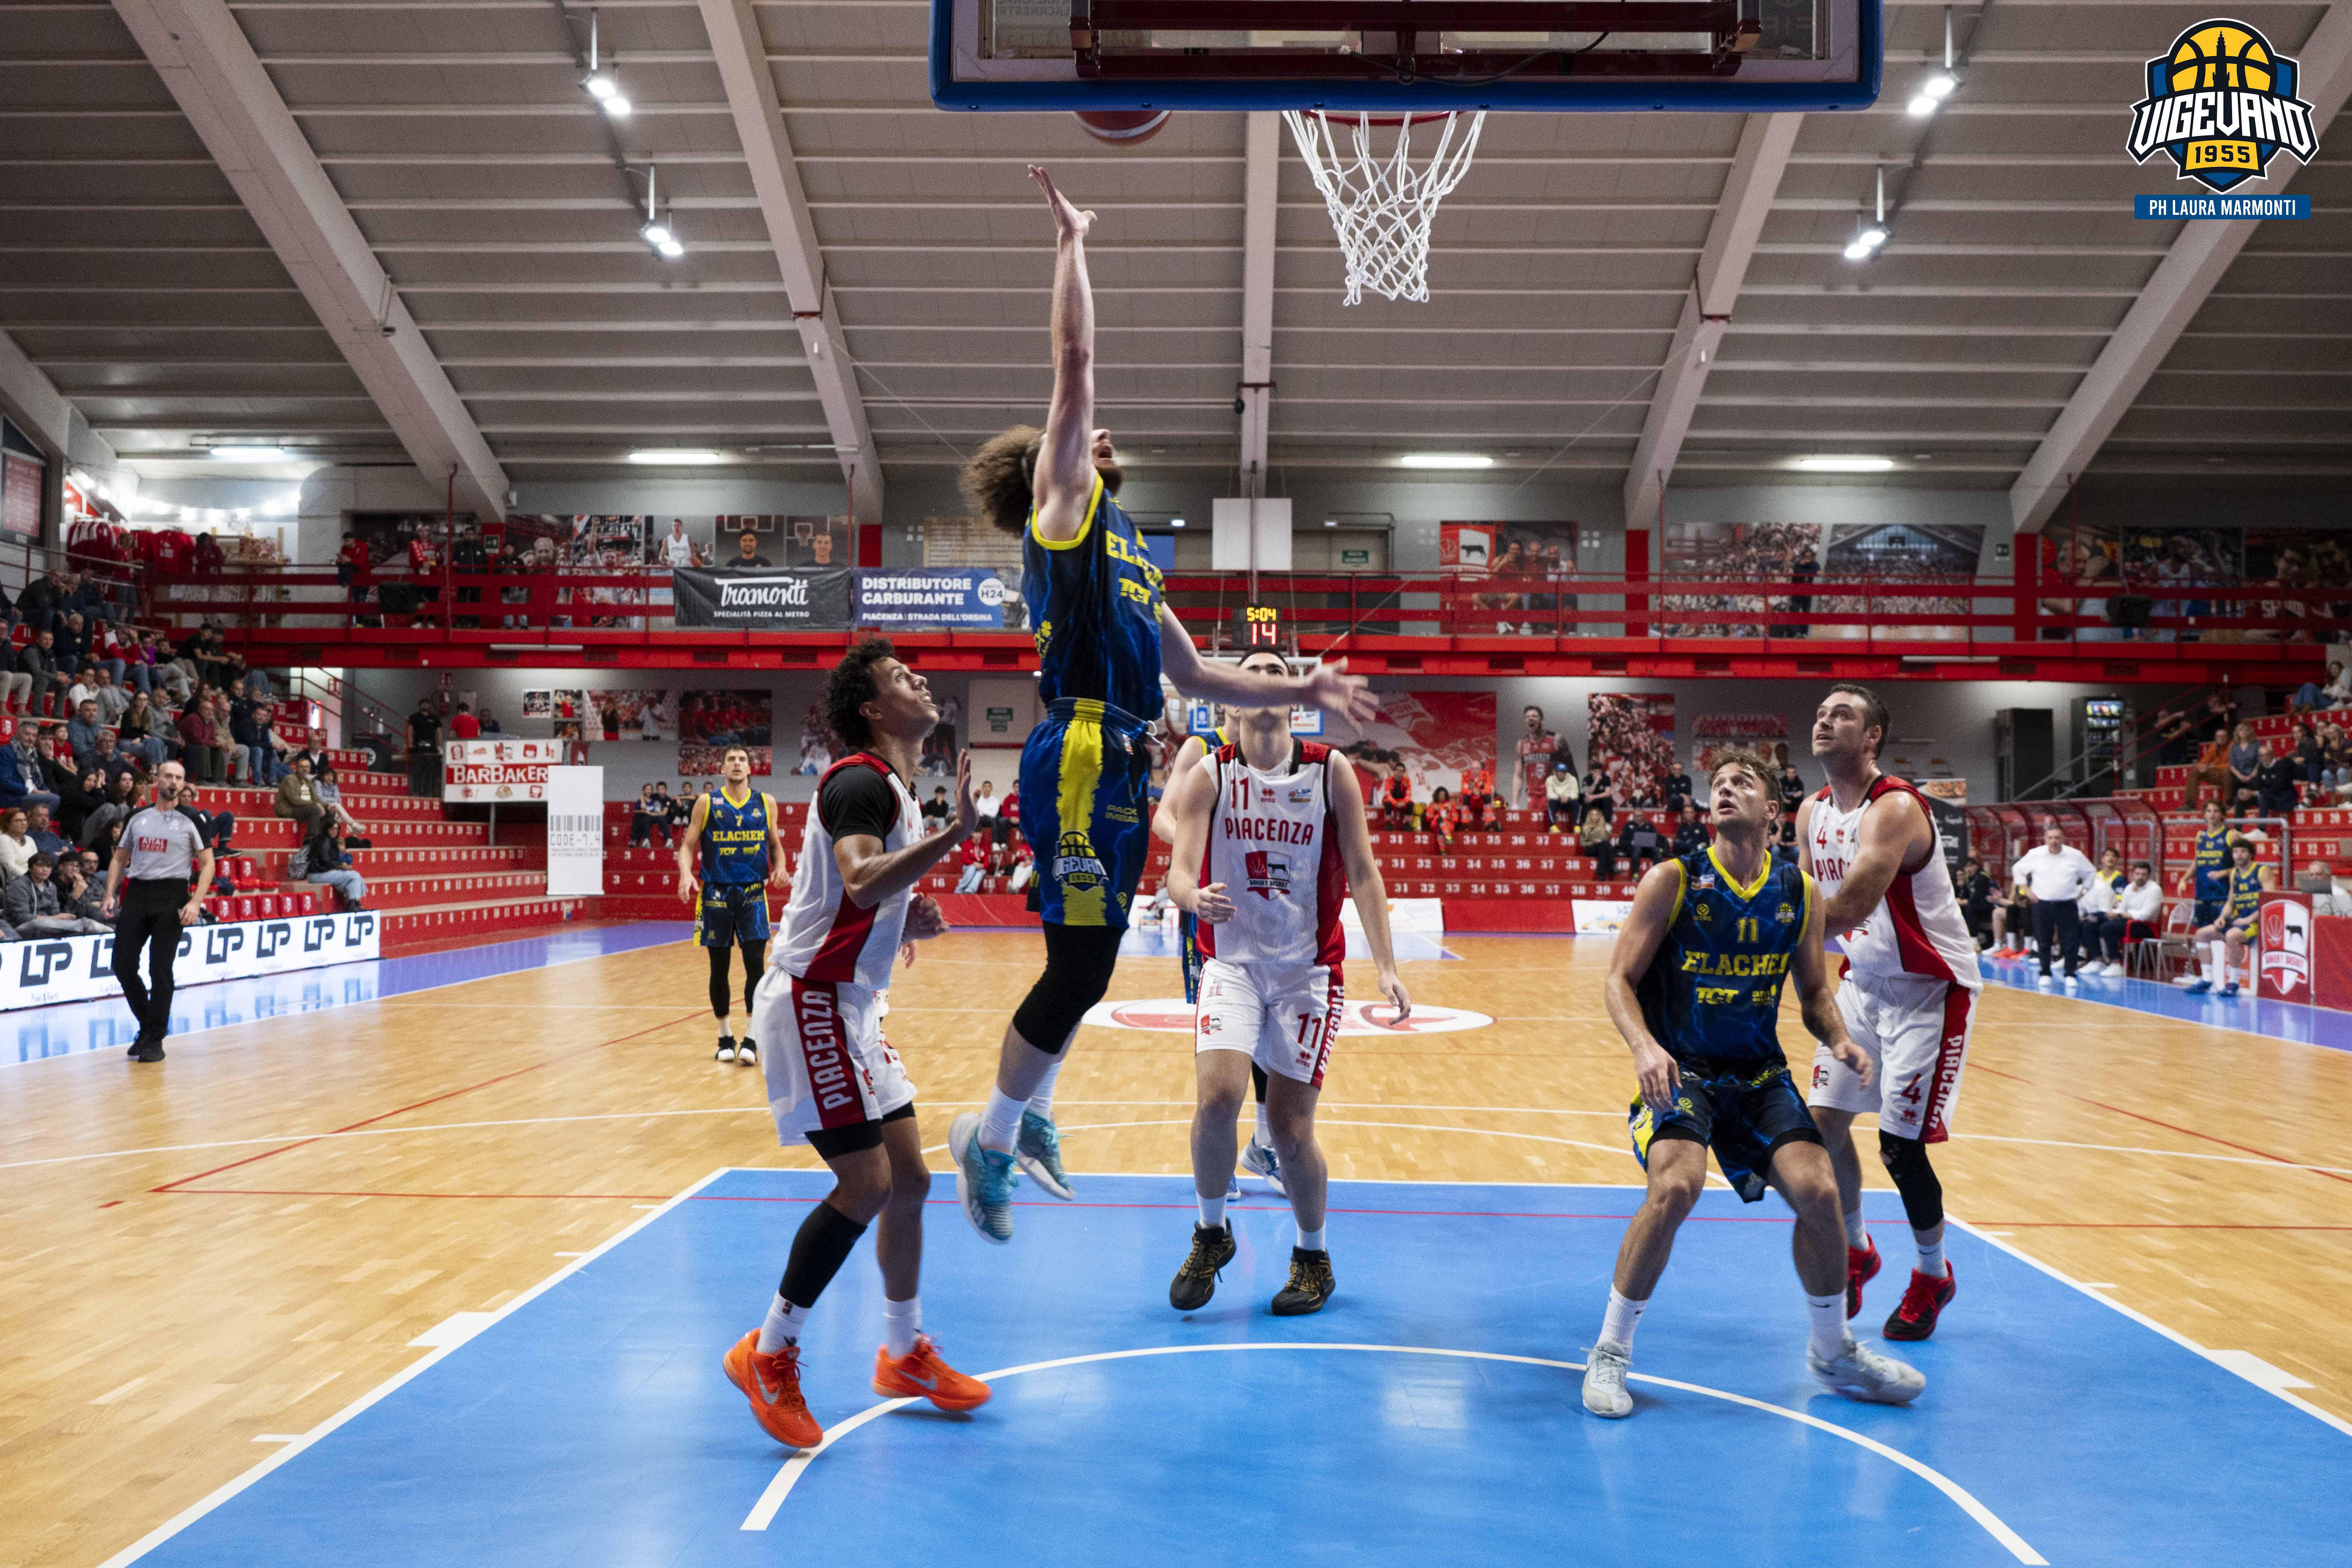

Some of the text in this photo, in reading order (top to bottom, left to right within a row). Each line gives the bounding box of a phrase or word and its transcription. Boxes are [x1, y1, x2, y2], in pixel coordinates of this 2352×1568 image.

[862, 577, 972, 590] DISTRIBUTORE
[714, 577, 809, 607] Tramonti
[862, 592, 964, 605] CARBURANTE
[981, 589, 1003, 599] H24
[714, 609, 752, 618] SPECIALITÀ
[863, 612, 903, 621] PIACENZA
[907, 613, 940, 621] STRADA
[1247, 607, 1276, 621] 5:04
[1251, 623, 1277, 646] 14
[1230, 777, 1248, 810] 11
[735, 815, 743, 827] 7
[712, 830, 765, 842] ELACHEM
[1225, 817, 1314, 846] PIACENZA
[1391, 835, 1402, 844] 31
[1414, 834, 1428, 844] 32
[1464, 836, 1477, 844] 34
[1393, 859, 1404, 868] 31
[1418, 859, 1430, 868] 32
[1443, 859, 1455, 868] 33
[1468, 859, 1480, 868] 34
[1492, 860, 1505, 868] 35
[1542, 860, 1553, 868] 37
[637, 875, 644, 885] 4
[662, 875, 669, 885] 5
[1396, 884, 1407, 892] 31
[1421, 884, 1434, 892] 32
[1446, 883, 1460, 893] 33
[1472, 884, 1485, 893] 34
[1496, 885, 1509, 893] 35
[1736, 917, 1759, 943] 11
[1297, 1013, 1321, 1048] 11
[1318, 985, 1344, 1075] PIACENZA
[802, 990, 852, 1110] PIACENZA
[1901, 1073, 1921, 1104] 4
[1929, 1035, 1963, 1129] PIACENZA
